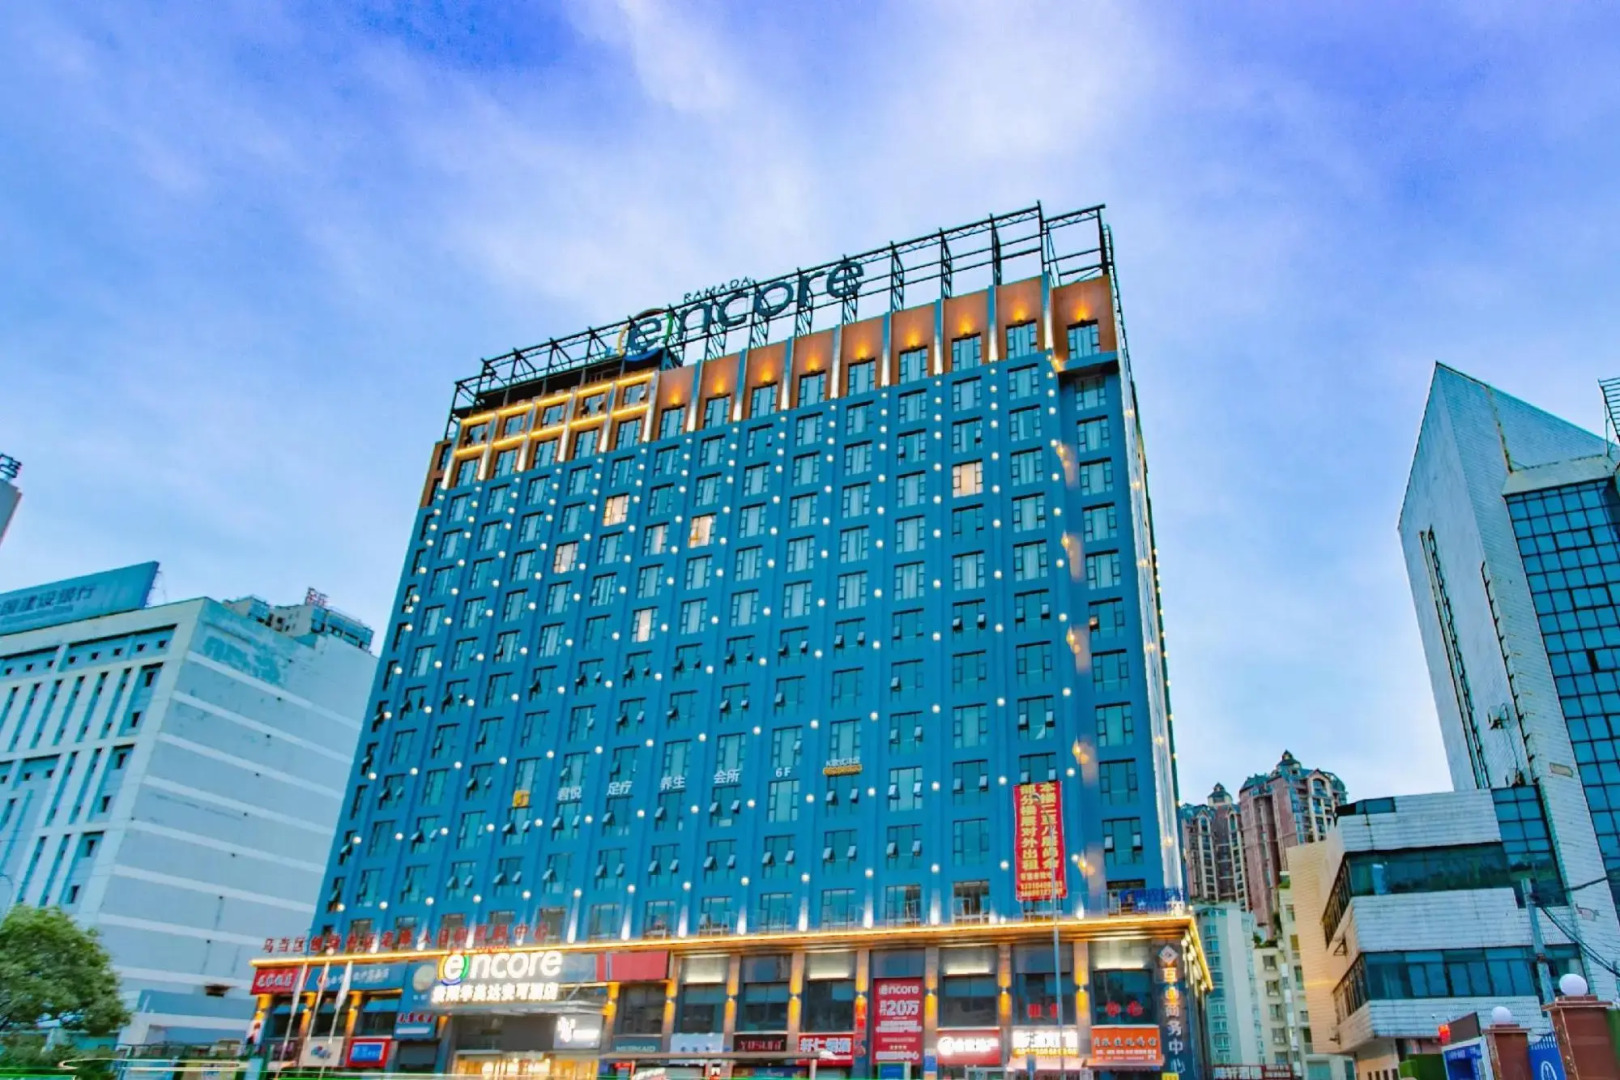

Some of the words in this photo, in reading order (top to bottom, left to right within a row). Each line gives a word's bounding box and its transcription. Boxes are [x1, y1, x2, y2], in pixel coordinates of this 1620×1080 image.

[683, 276, 751, 303] RAMADA
[627, 261, 864, 352] encore
[606, 780, 633, 796] 足疗
[660, 775, 686, 791] 养生
[713, 769, 742, 784] 会所
[775, 767, 792, 778] 6F
[443, 950, 563, 980] encore
[879, 984, 919, 995] encore
